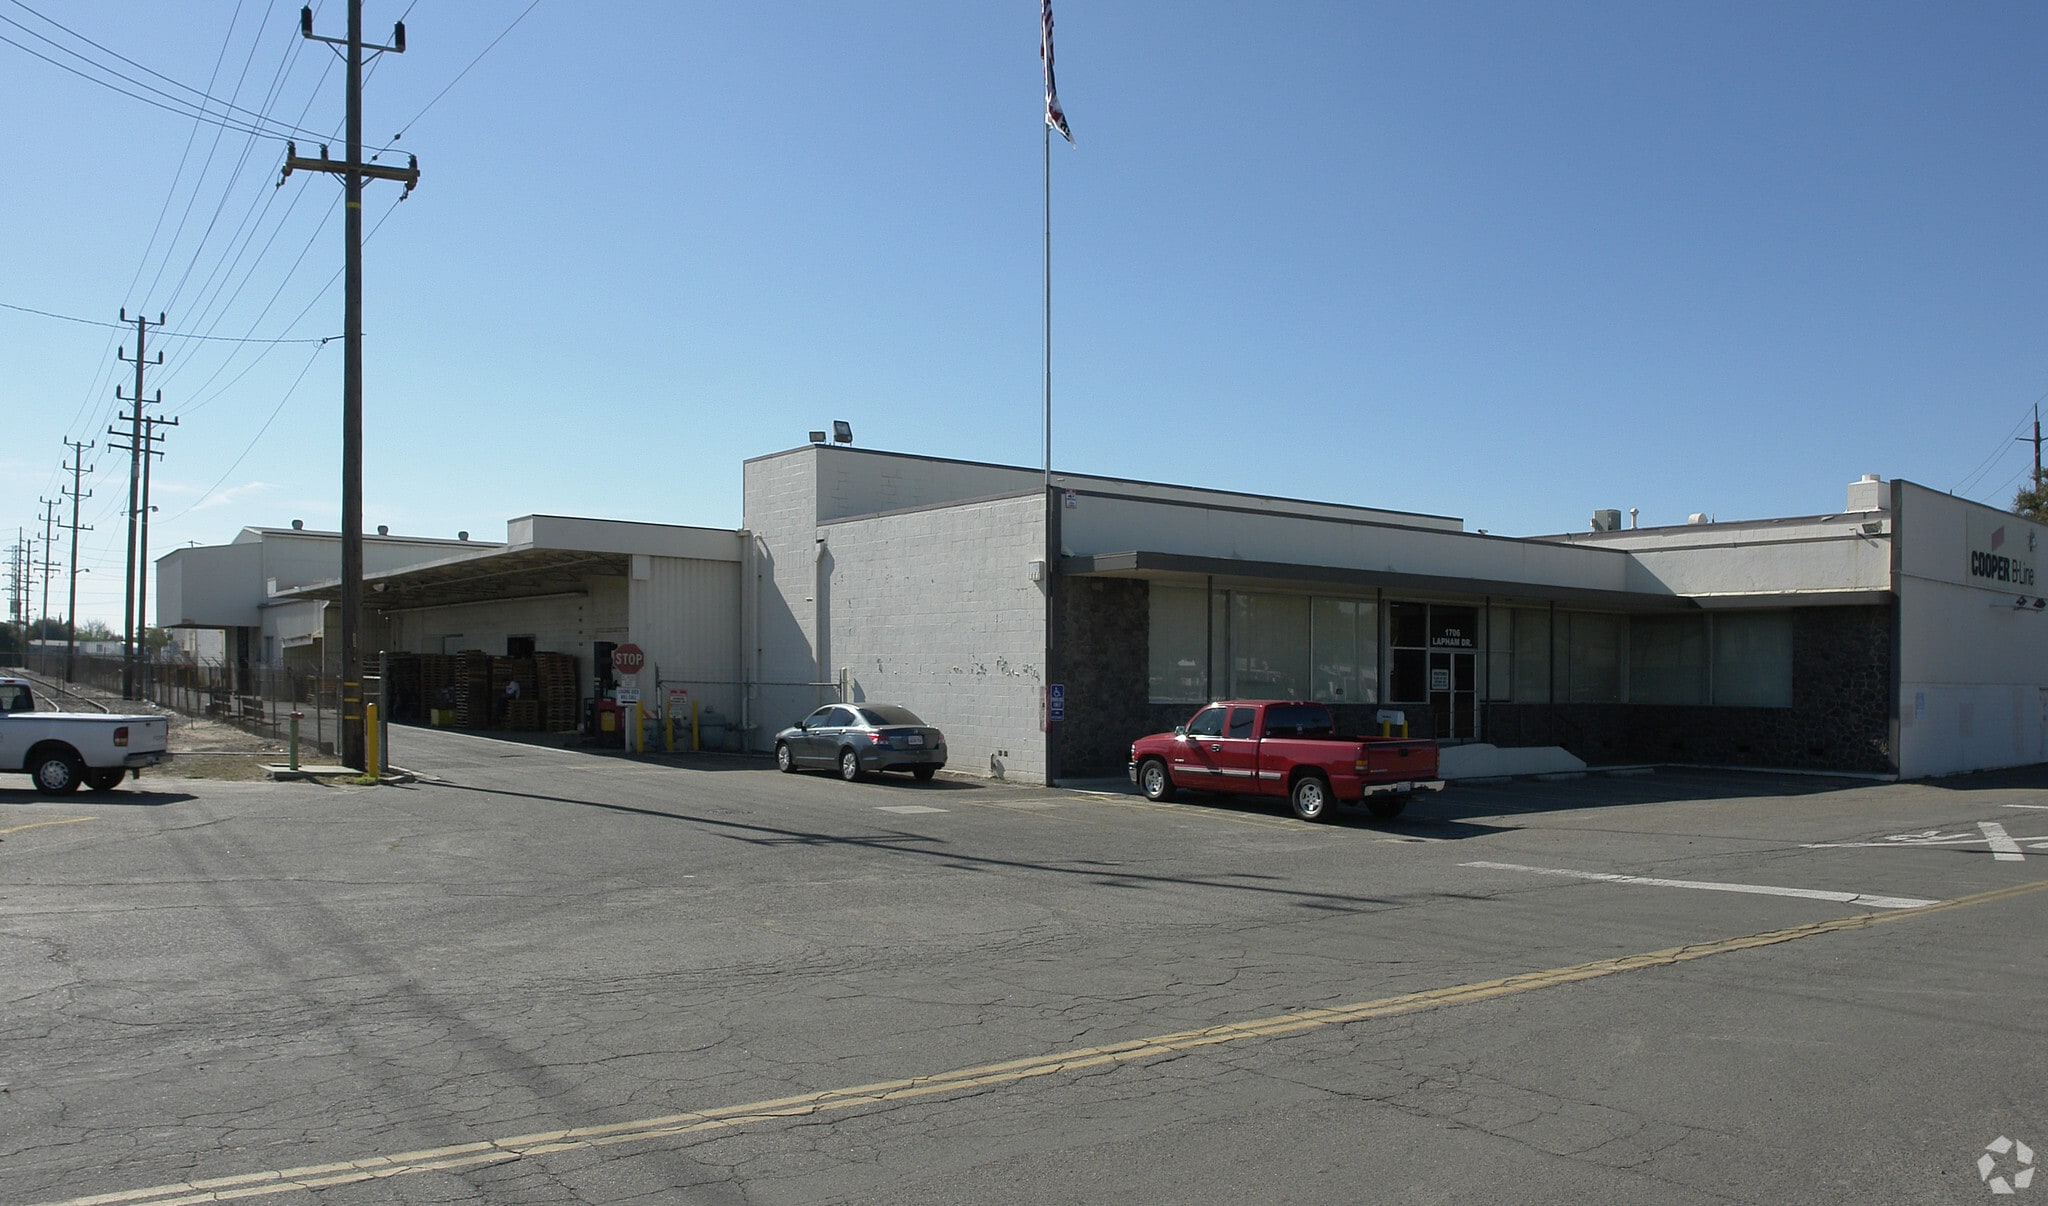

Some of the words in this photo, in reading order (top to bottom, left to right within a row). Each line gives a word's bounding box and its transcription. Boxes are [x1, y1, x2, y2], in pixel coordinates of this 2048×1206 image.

[1971, 550, 2010, 582] COOPER
[1432, 637, 1460, 646] LAPHAM
[615, 653, 643, 665] STOP
